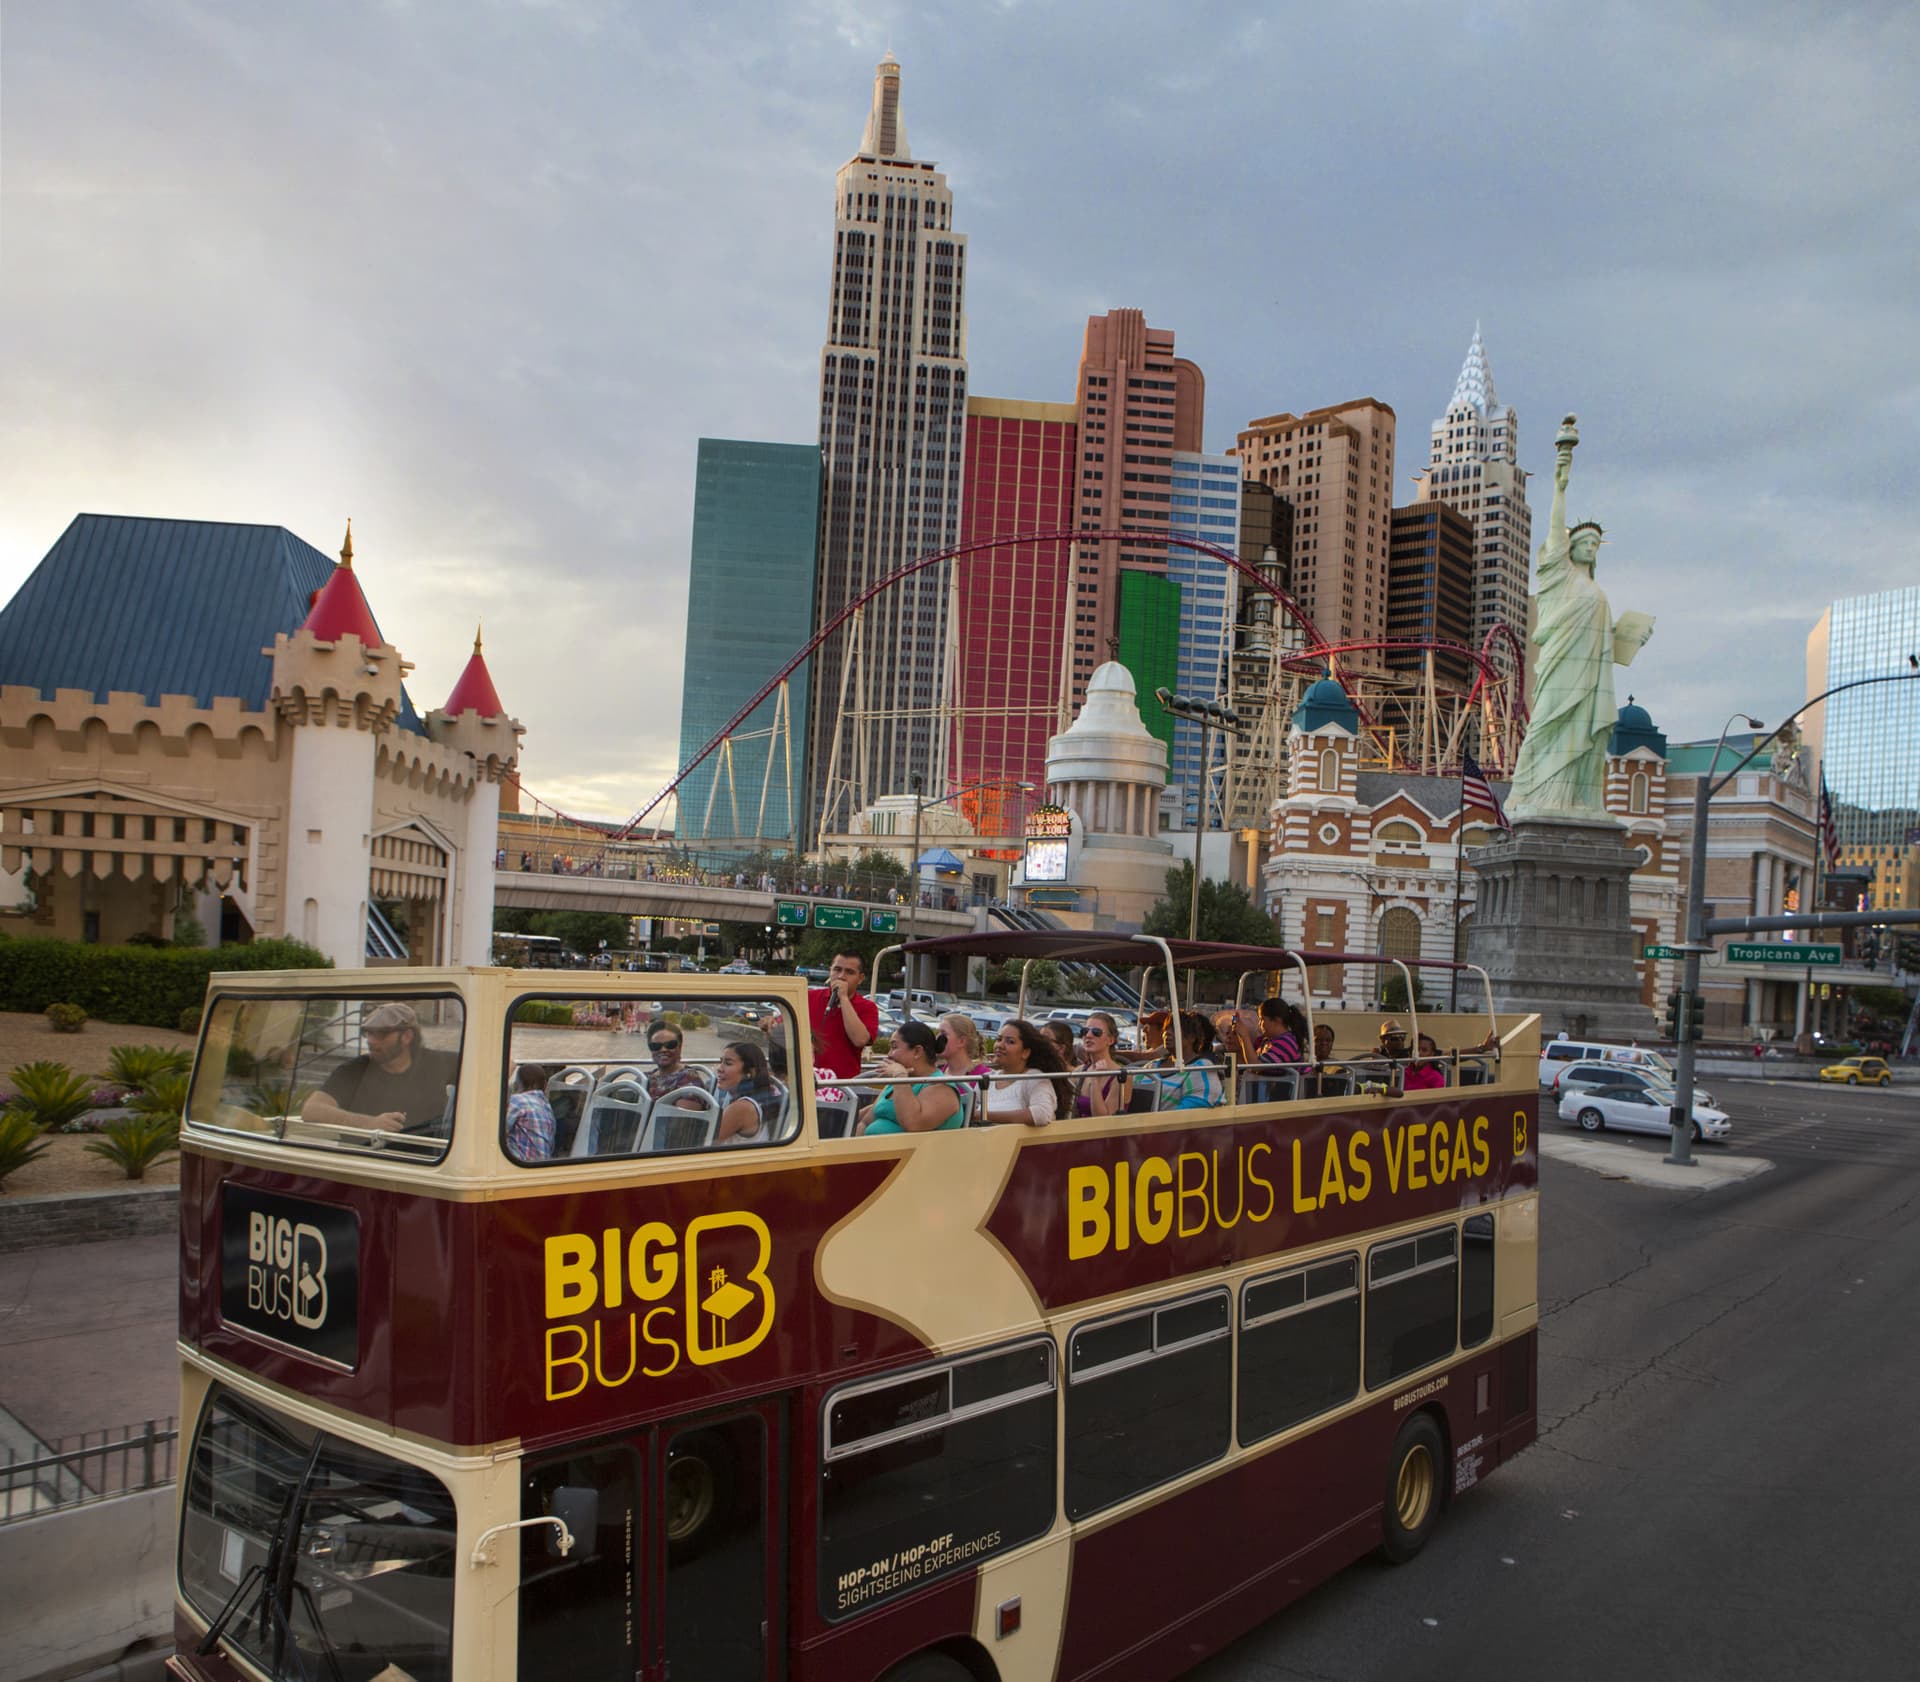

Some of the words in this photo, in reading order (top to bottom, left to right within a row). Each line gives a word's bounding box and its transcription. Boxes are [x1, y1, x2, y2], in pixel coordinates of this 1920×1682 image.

[1025, 814, 1045, 824] NEW
[1046, 812, 1069, 824] YORK
[1025, 825, 1045, 835] NEW
[1046, 824, 1069, 835] YORK
[1647, 948, 1656, 957] W
[1732, 947, 1800, 961] Tropicana
[1808, 949, 1836, 961] Ave
[1293, 1129, 1372, 1214] LAS
[1383, 1115, 1490, 1194] VEGAS
[249, 1211, 293, 1270] BIG
[248, 1265, 292, 1320] BUS
[545, 1221, 679, 1320] BIG
[545, 1306, 680, 1401] BUS
[1393, 1375, 1449, 1411] BIGBUSTOURS.COM
[838, 1558, 890, 1592] HOP-ON
[900, 1533, 954, 1567] HOP-OFF
[838, 1563, 921, 1610] SIGHTSEEING
[924, 1530, 1001, 1574] EXPERIENCES
